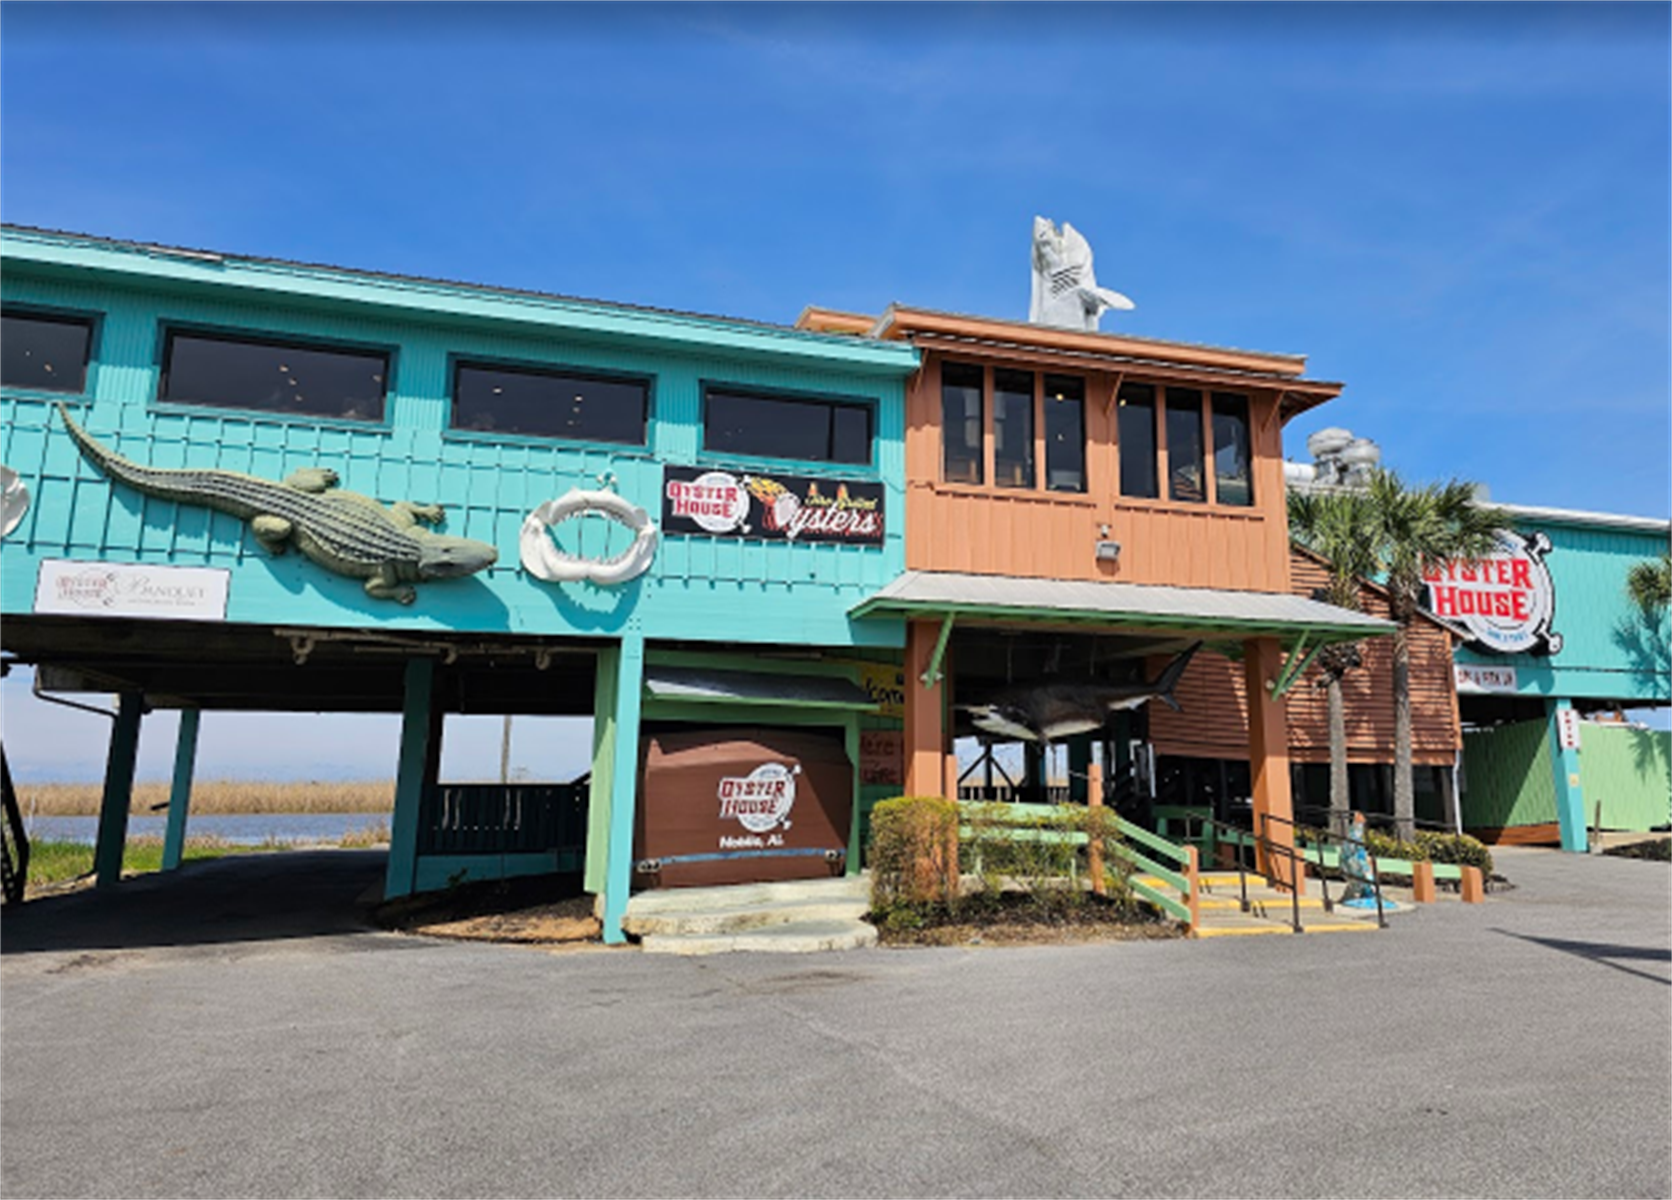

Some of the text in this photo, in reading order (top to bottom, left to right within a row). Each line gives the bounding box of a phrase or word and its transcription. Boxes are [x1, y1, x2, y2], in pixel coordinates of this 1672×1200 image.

[669, 482, 737, 502] OYSTER
[676, 499, 733, 518] HOUSE
[1434, 586, 1529, 621] HOUSE
[721, 781, 786, 798] OYSTER
[724, 799, 777, 815] HOUSE
